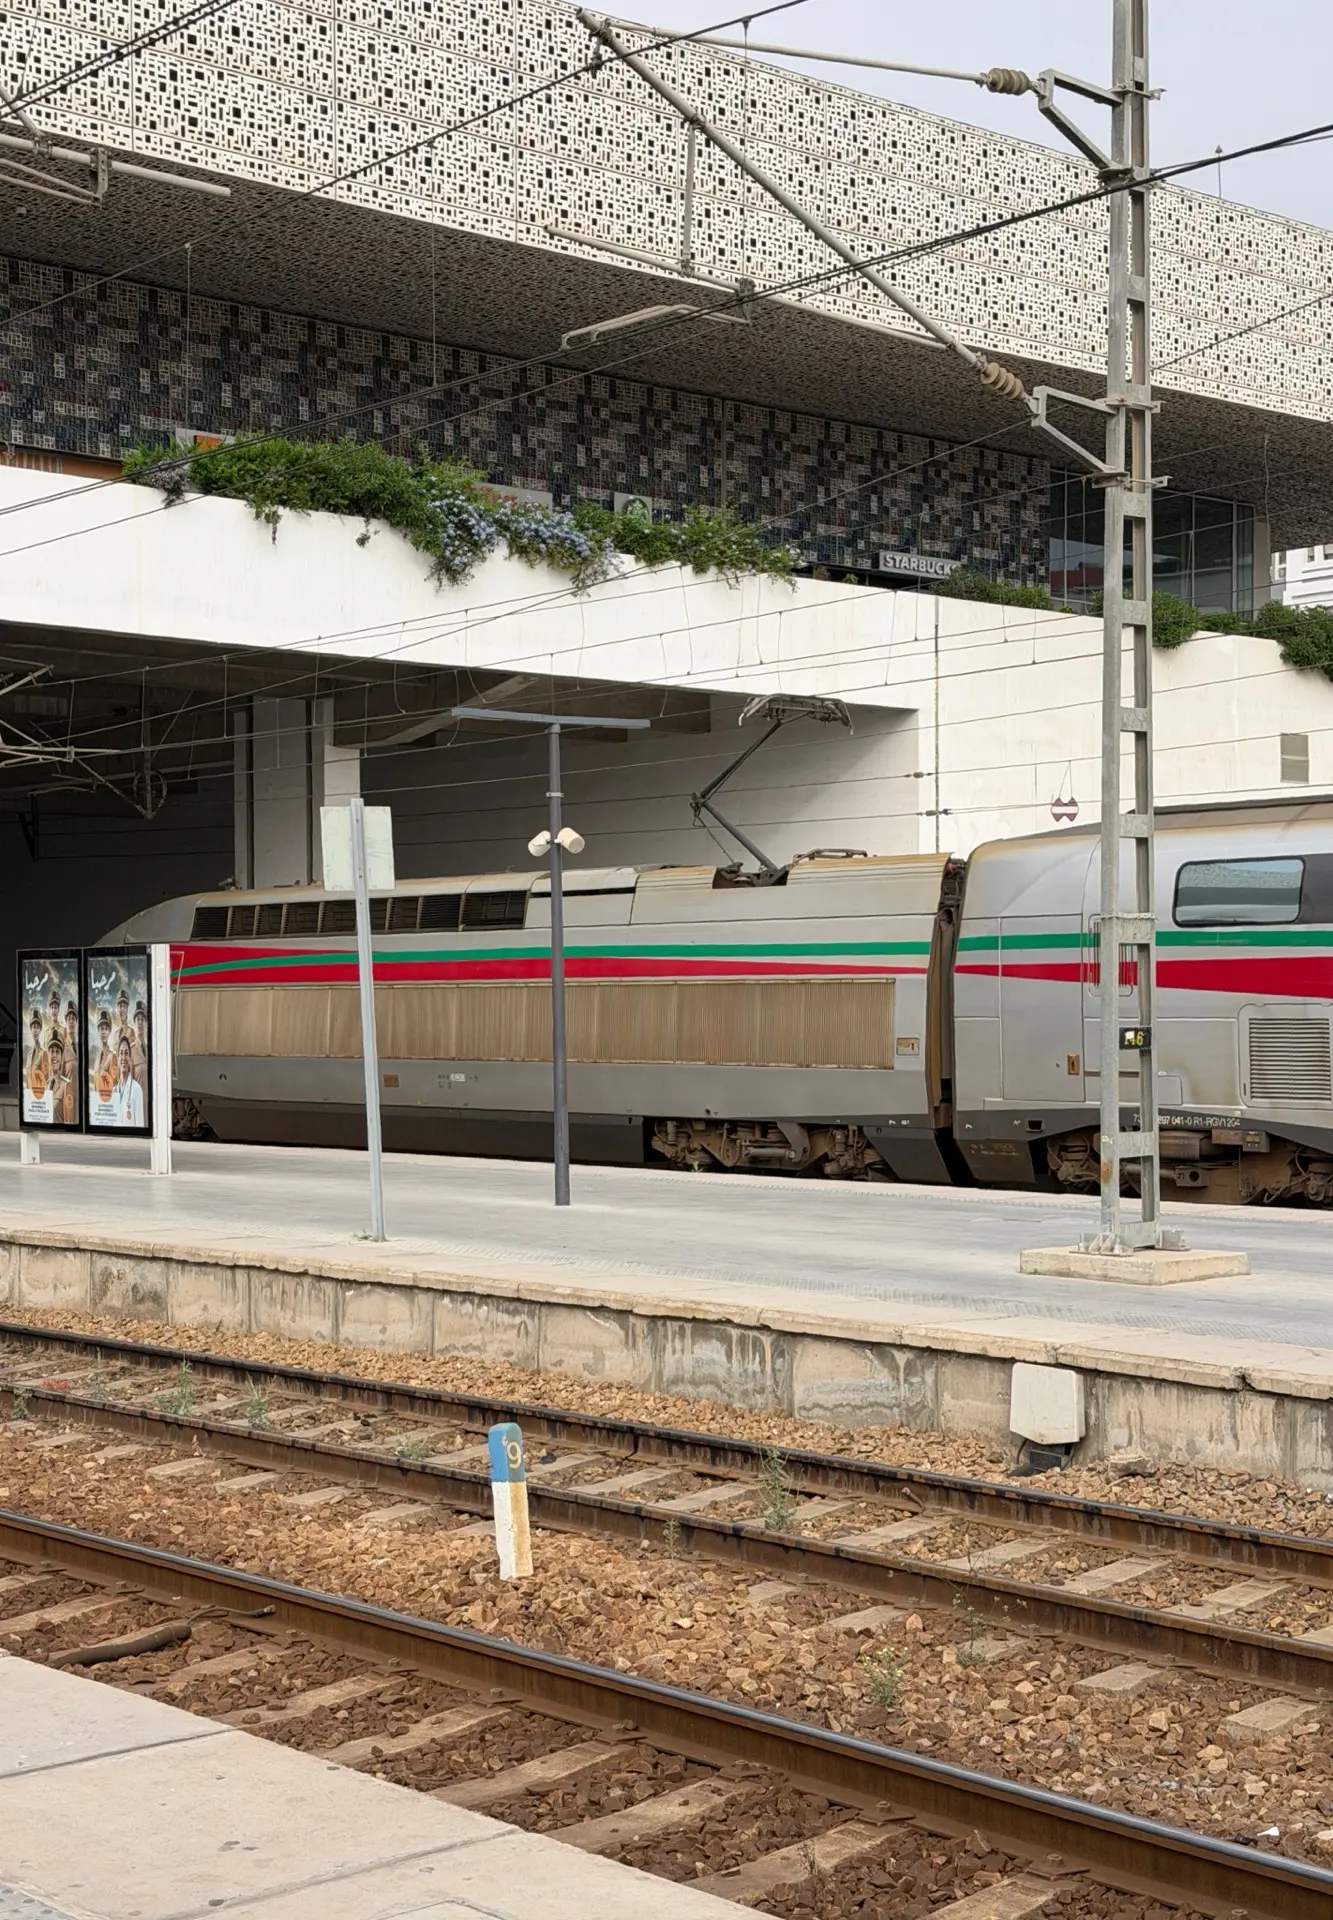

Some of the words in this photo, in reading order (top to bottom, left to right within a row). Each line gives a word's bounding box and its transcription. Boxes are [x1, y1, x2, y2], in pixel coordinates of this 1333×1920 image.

[25, 968, 49, 994] مرحبا
[91, 968, 116, 994] مرحبا
[507, 1441, 522, 1469] 9
